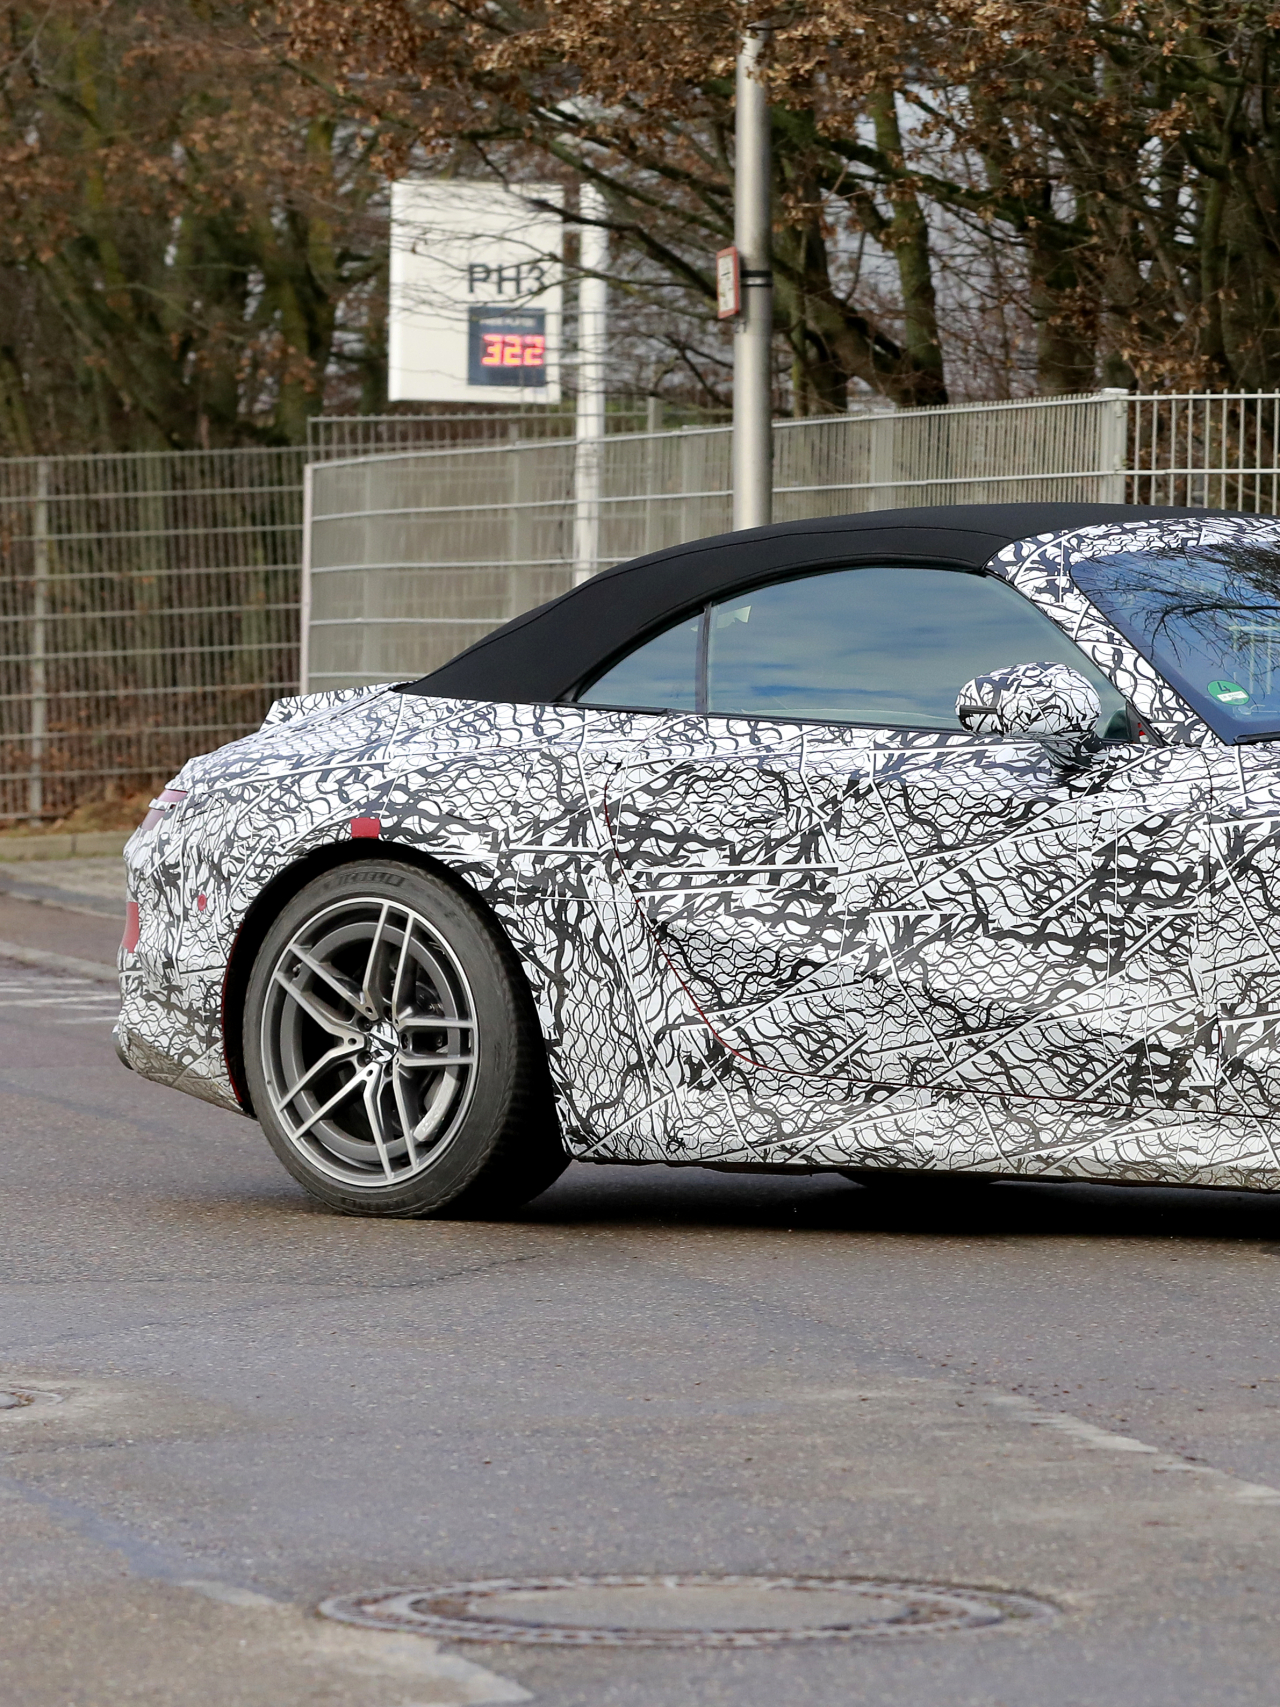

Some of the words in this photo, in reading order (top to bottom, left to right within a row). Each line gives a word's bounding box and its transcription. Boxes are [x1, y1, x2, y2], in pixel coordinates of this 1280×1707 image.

[468, 264, 546, 294] PH3
[482, 333, 545, 367] 322
[1217, 682, 1231, 692] 4
